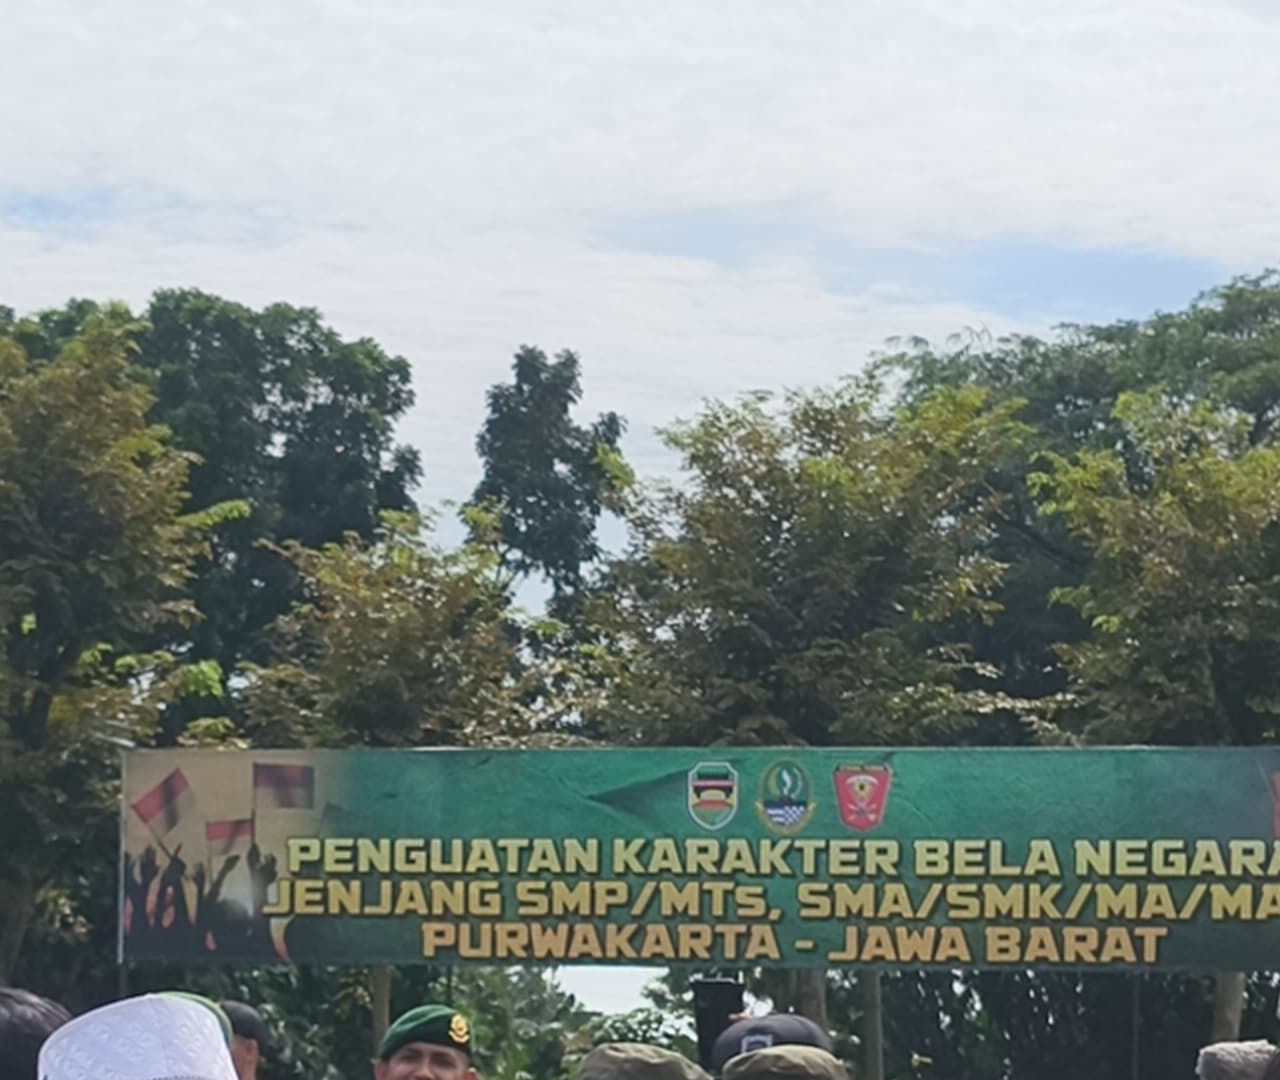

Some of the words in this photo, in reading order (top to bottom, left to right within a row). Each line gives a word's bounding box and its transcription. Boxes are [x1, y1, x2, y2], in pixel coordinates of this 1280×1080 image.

[287, 838, 598, 874] PENGUATAN
[613, 838, 900, 876] KARAKTER
[914, 840, 1060, 876] BELA
[263, 880, 503, 916] JENJANG
[421, 922, 781, 960] PURWAKARTA
[828, 926, 973, 962] JAWA
[986, 927, 1169, 963] BARAT
